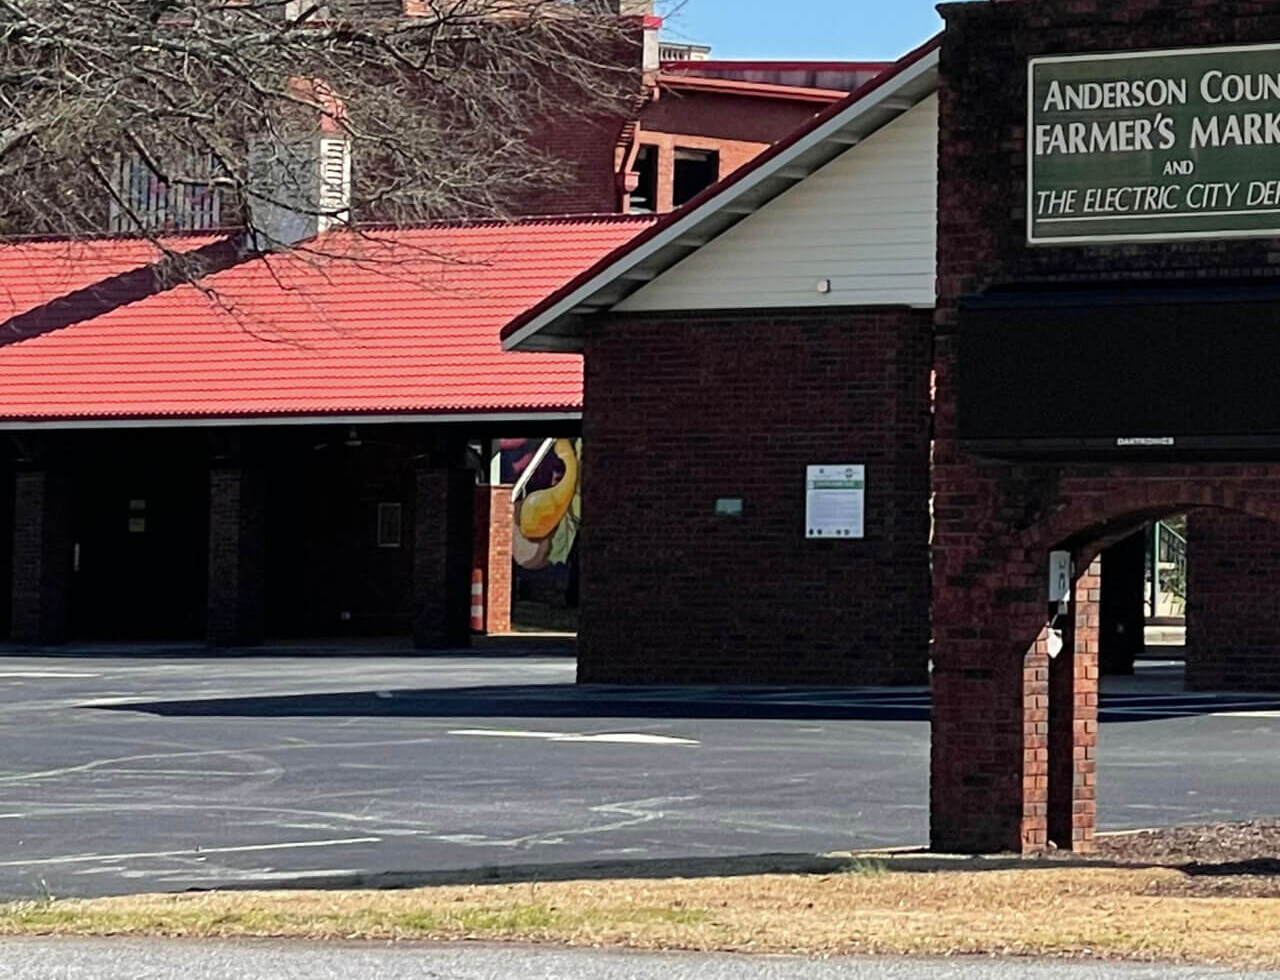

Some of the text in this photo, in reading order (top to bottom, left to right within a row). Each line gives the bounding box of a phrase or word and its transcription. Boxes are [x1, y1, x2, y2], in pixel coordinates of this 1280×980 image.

[1043, 78, 1187, 112] ANDERSON
[1035, 113, 1175, 155] FARMER'S
[1163, 160, 1193, 175] AND
[1037, 190, 1077, 214] THE
[1083, 185, 1180, 213] ELECTRIC
[1186, 182, 1240, 208] CITY
